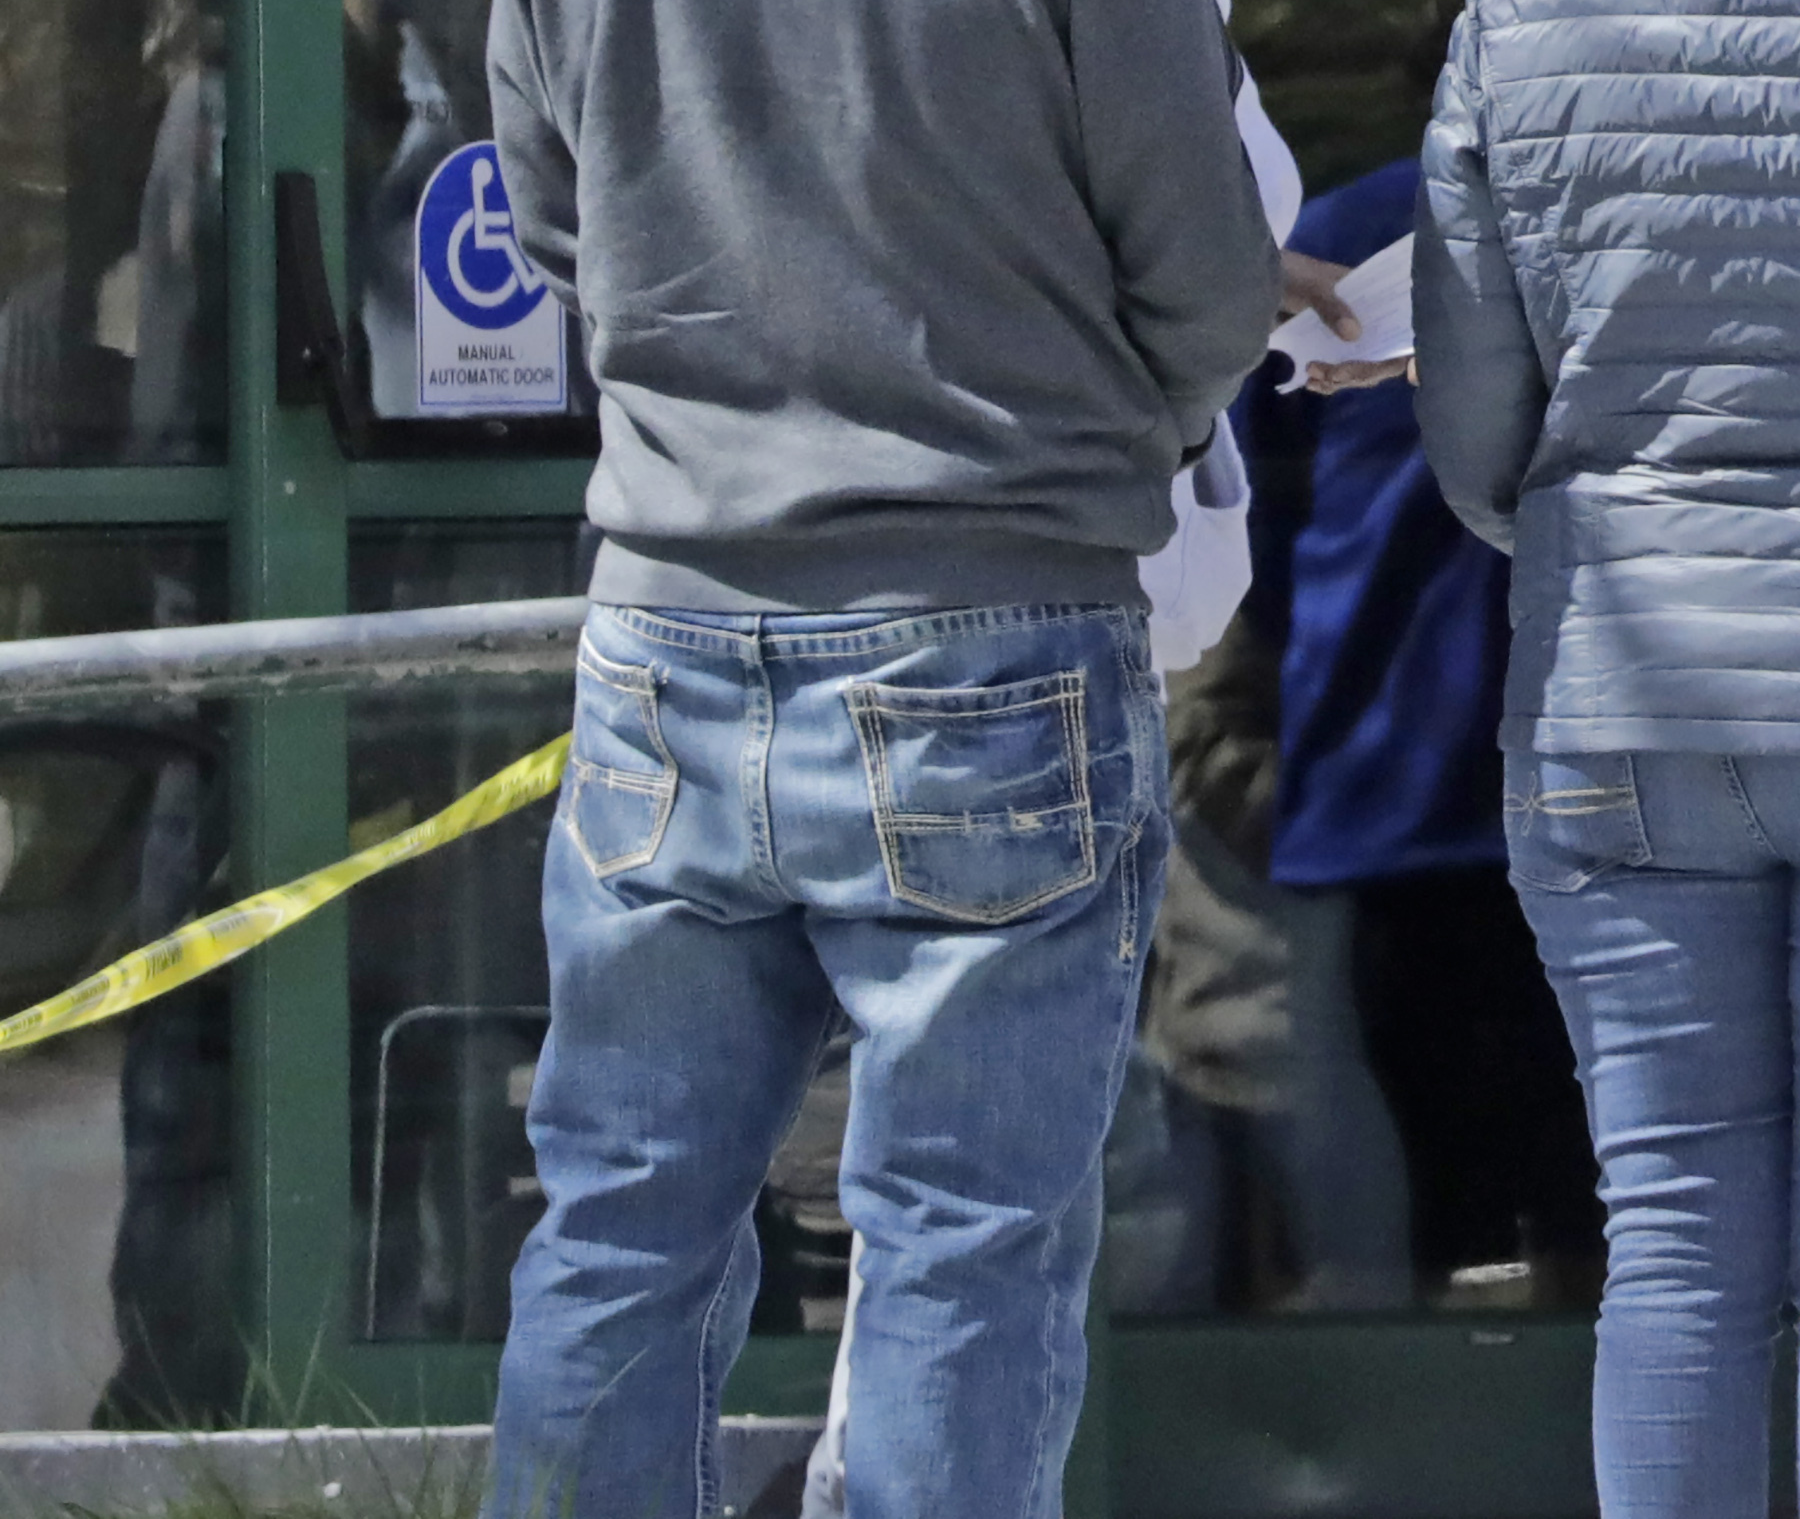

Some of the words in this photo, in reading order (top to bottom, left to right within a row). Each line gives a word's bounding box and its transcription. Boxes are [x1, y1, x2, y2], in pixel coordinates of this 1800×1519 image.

[457, 343, 517, 361] MANUAL
[429, 368, 510, 386] AUTOMATIC
[513, 367, 555, 385] DOOR
